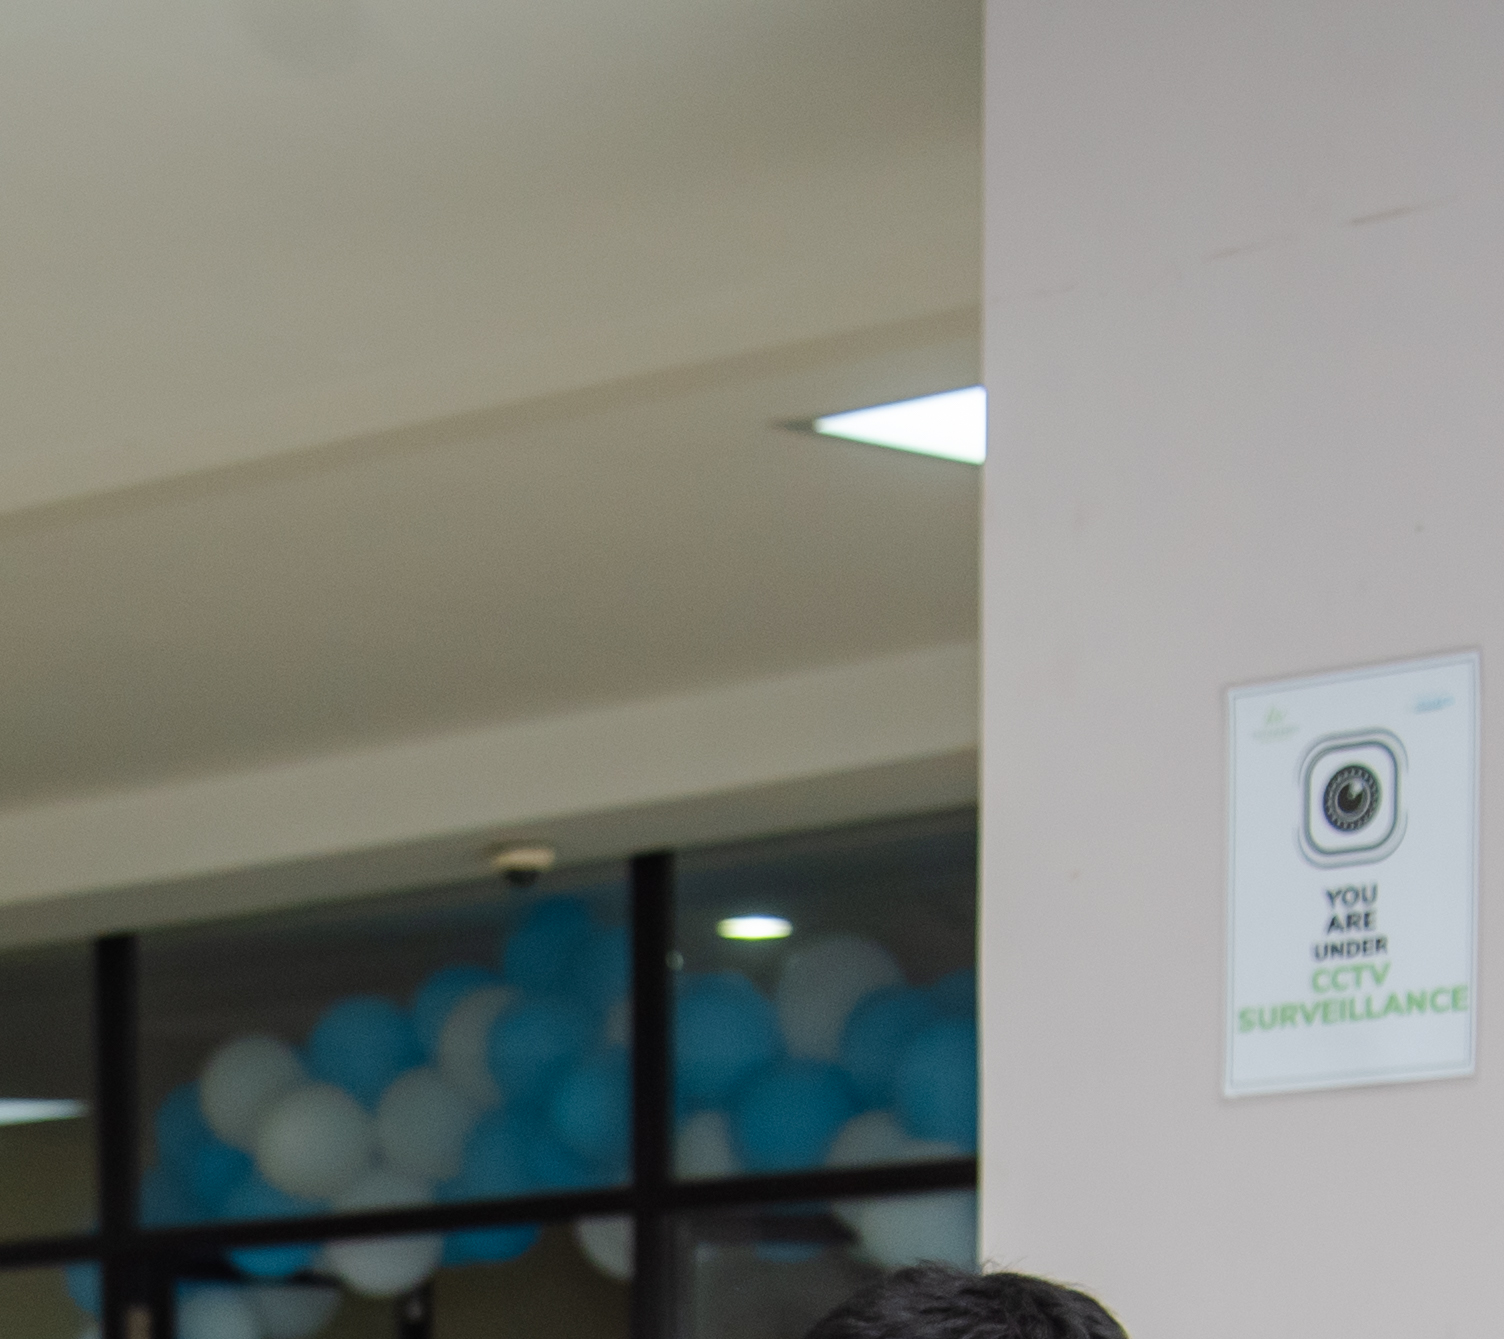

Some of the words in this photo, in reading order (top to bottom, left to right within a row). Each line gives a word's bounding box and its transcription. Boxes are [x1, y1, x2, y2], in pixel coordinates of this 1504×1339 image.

[1325, 882, 1379, 907] YOU
[1326, 910, 1377, 935] ARE
[1312, 937, 1389, 961] UNDER
[1311, 961, 1391, 994] CCTV
[1238, 984, 1469, 1034] SURVEILLANCE
